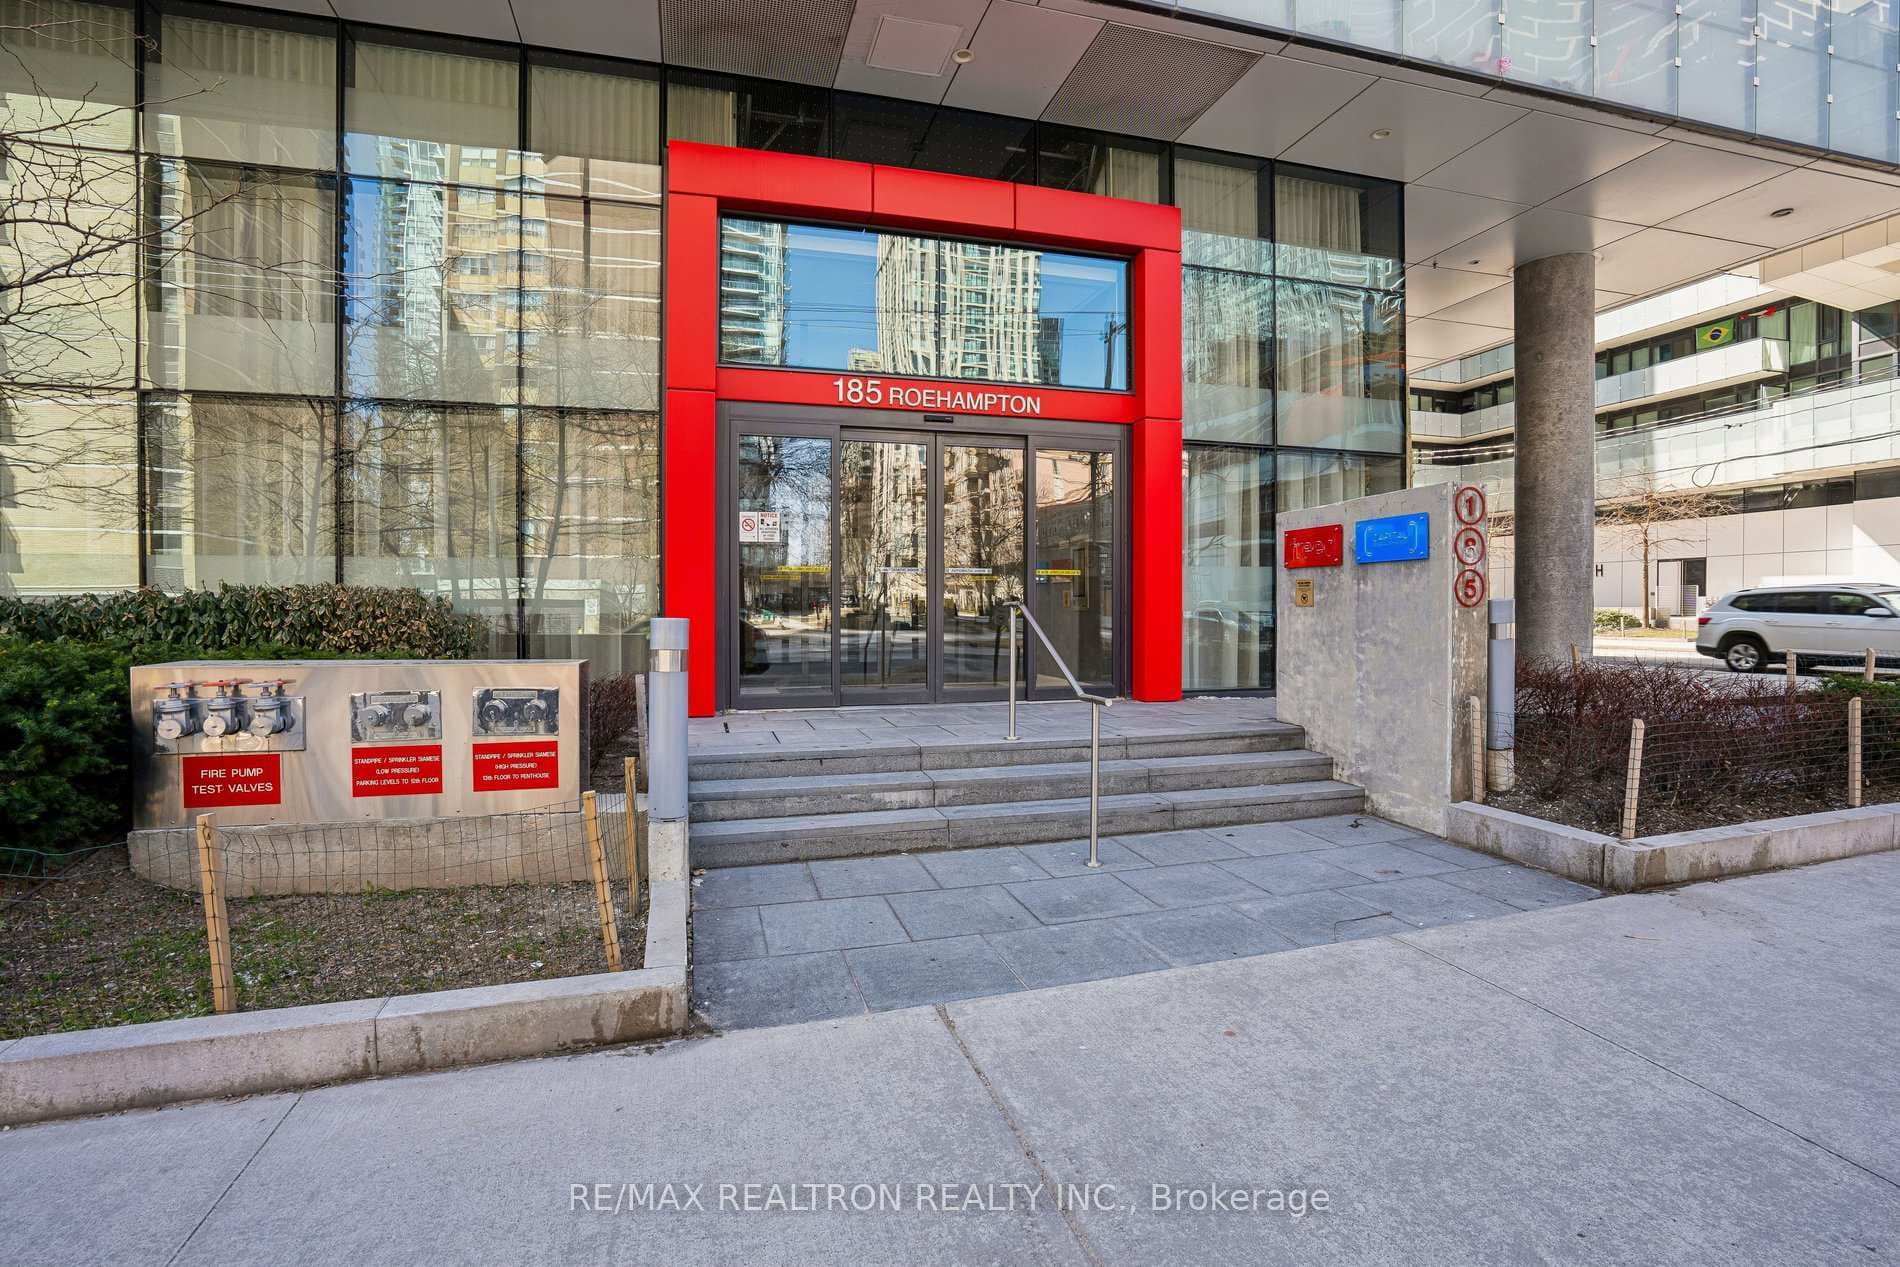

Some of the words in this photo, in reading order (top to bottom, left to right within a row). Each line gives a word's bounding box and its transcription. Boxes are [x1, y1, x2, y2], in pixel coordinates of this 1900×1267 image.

[833, 378, 882, 405] 185
[889, 387, 1041, 414] ROEHAMPTON
[354, 757, 382, 765] STANDPIPE
[200, 769, 227, 779] FIRE
[231, 767, 264, 778] PUMP
[191, 784, 223, 795] TEST
[228, 782, 273, 793] VALVES
[356, 779, 379, 787] PARKING
[380, 778, 400, 786] LEVELS
